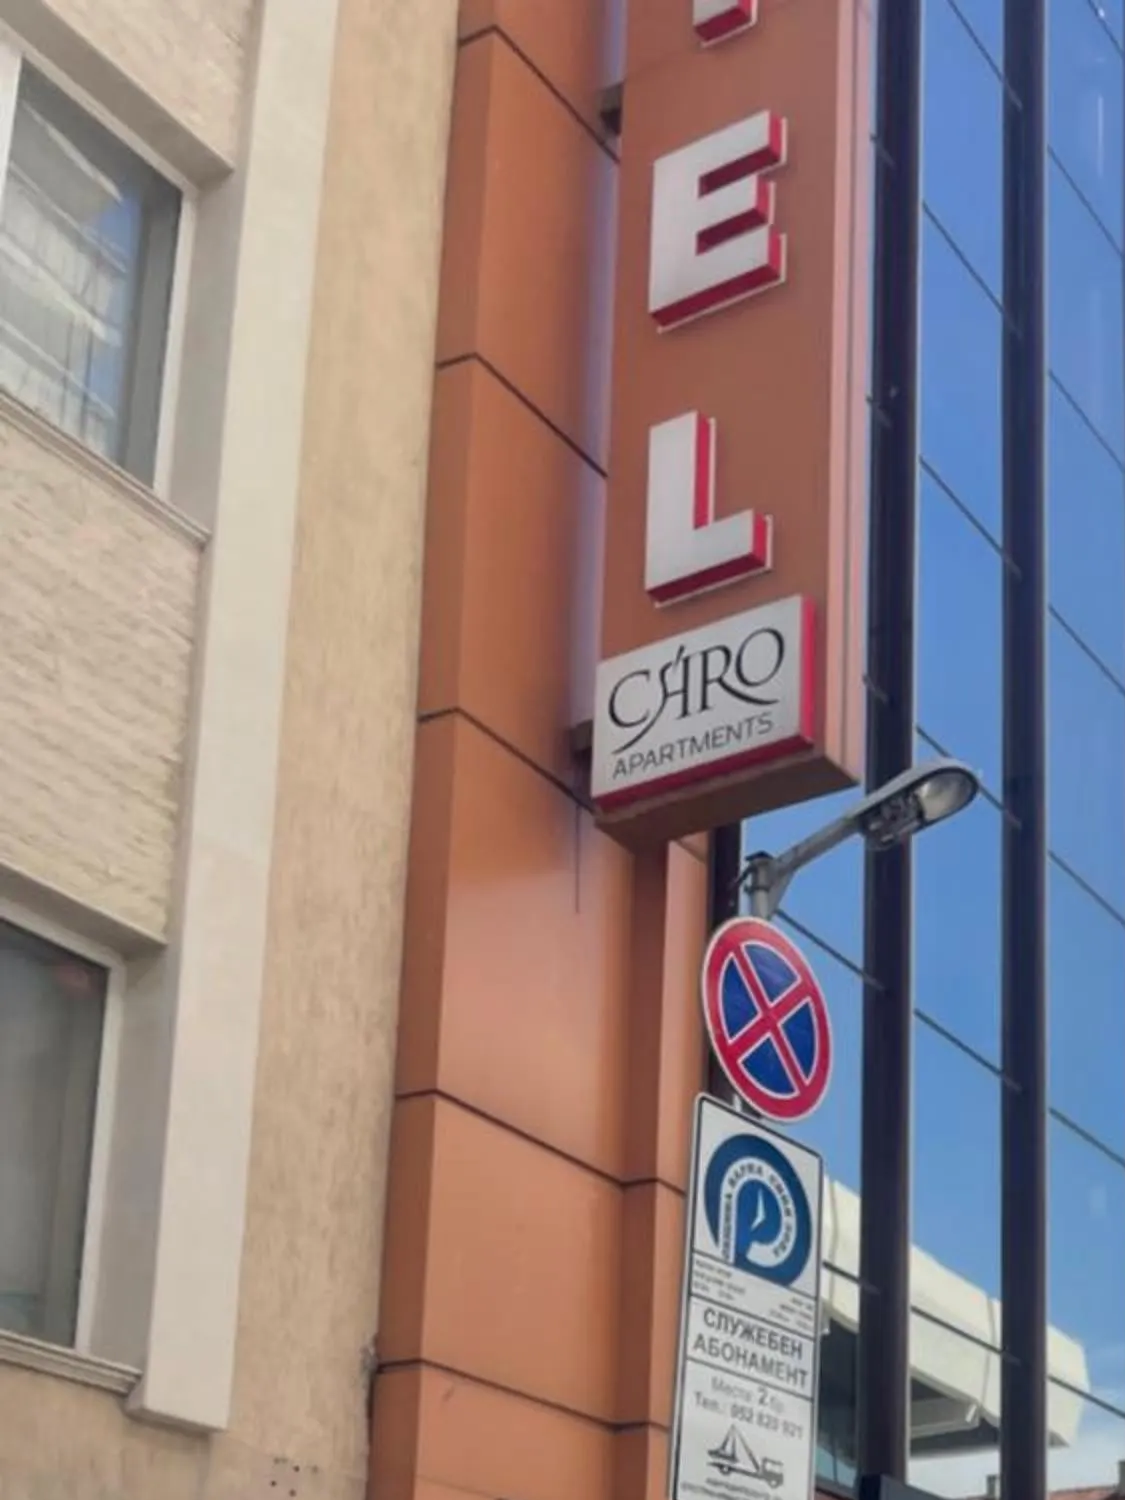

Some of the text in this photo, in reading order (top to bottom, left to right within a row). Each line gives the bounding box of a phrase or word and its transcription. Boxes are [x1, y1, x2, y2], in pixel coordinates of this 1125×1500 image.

[613, 711, 774, 780] APARTMENTS
[703, 1307, 802, 1359] СЛУЖЕБЕН
[694, 1334, 808, 1388] АБОНАМЕНТ
[757, 1385, 769, 1407] 2
